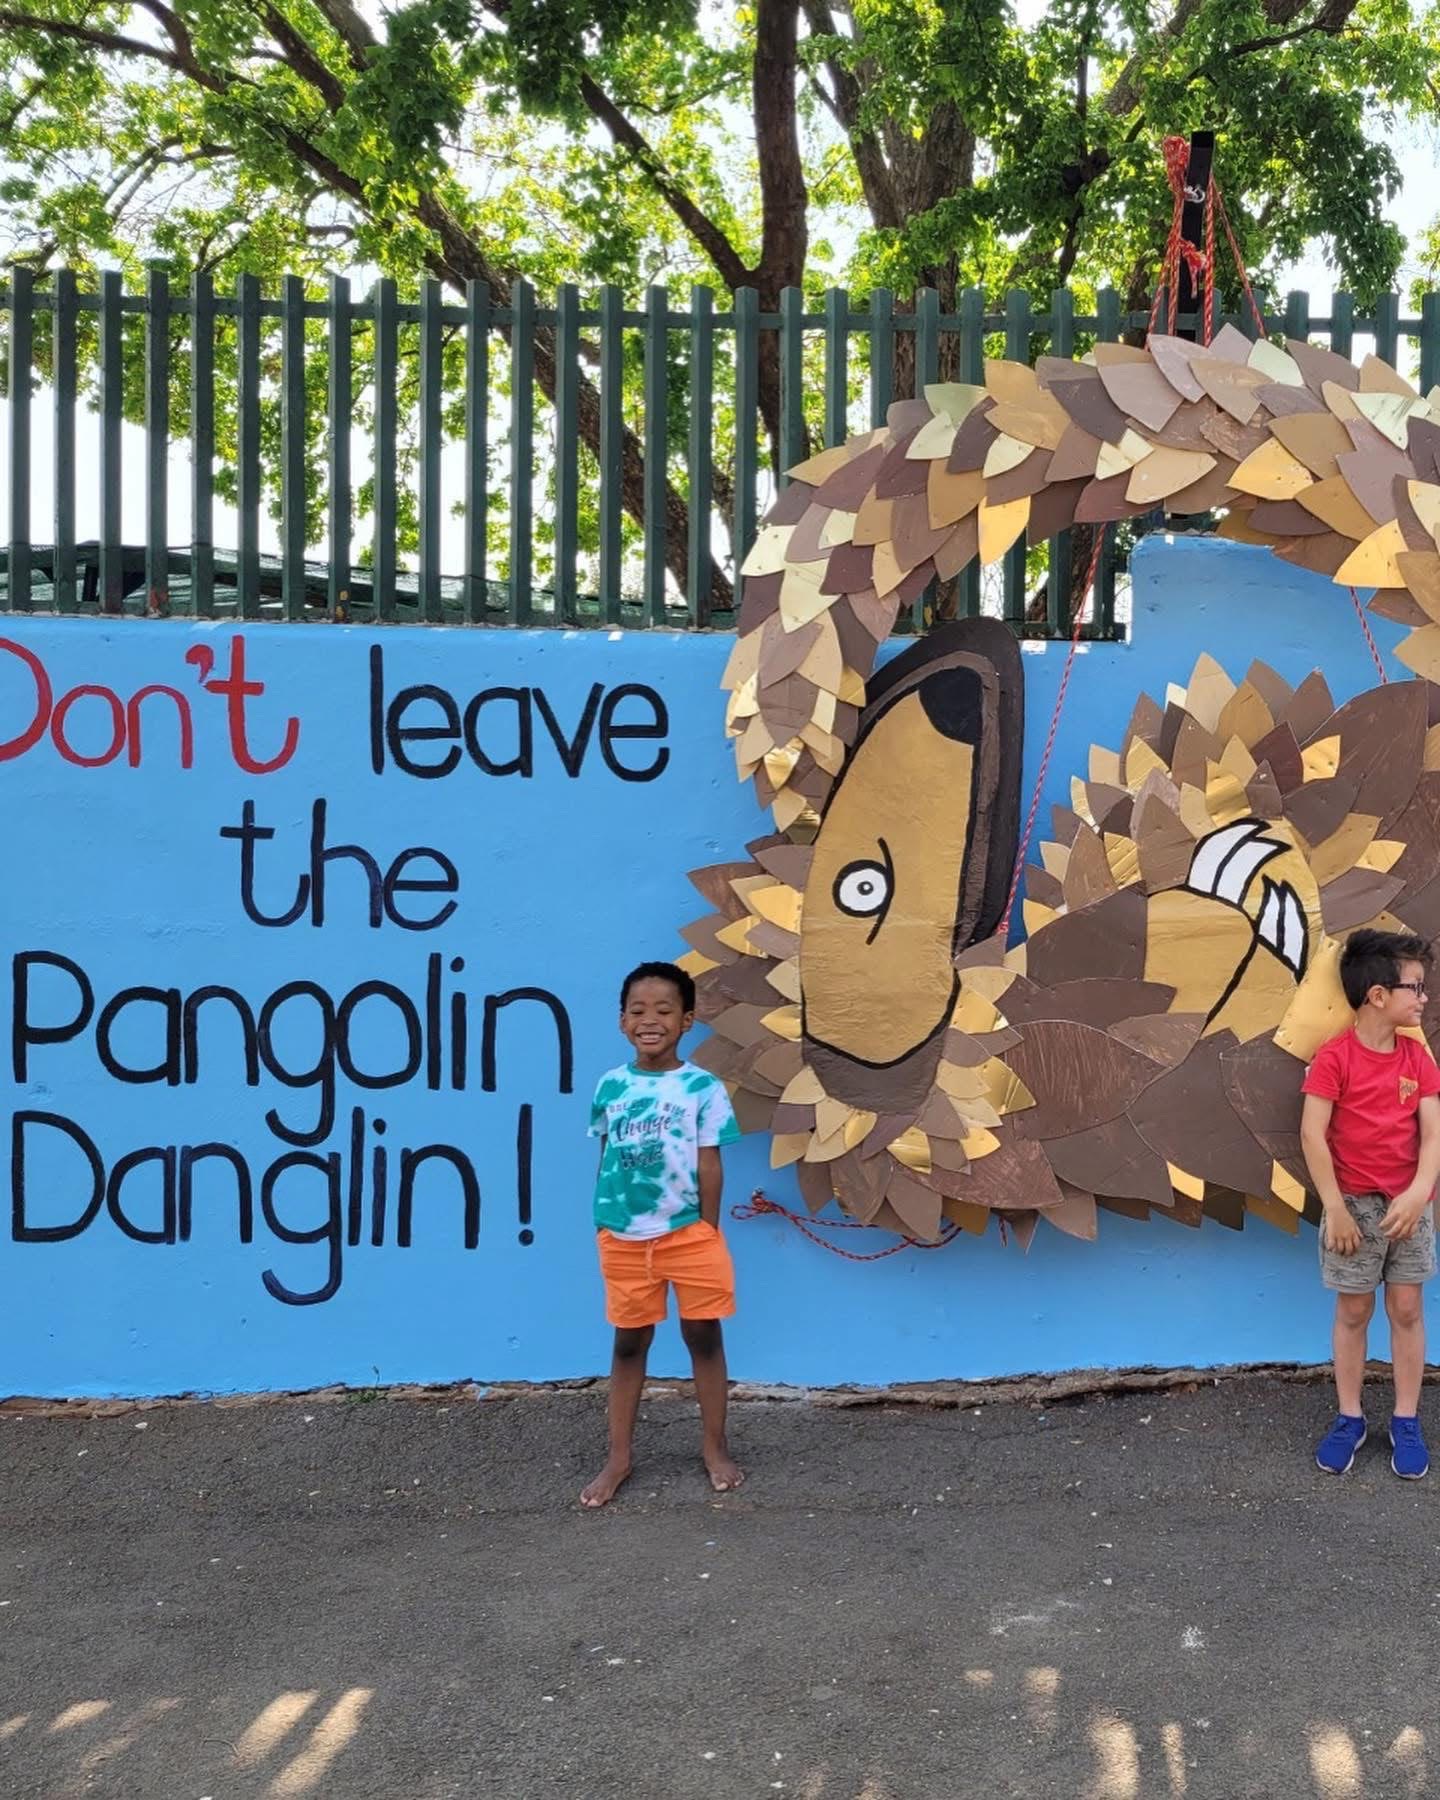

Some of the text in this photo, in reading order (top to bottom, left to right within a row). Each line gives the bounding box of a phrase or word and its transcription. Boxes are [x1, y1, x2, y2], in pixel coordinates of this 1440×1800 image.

[369, 644, 671, 783] leave
[219, 797, 460, 932] the
[12, 950, 574, 1148] Pangolin
